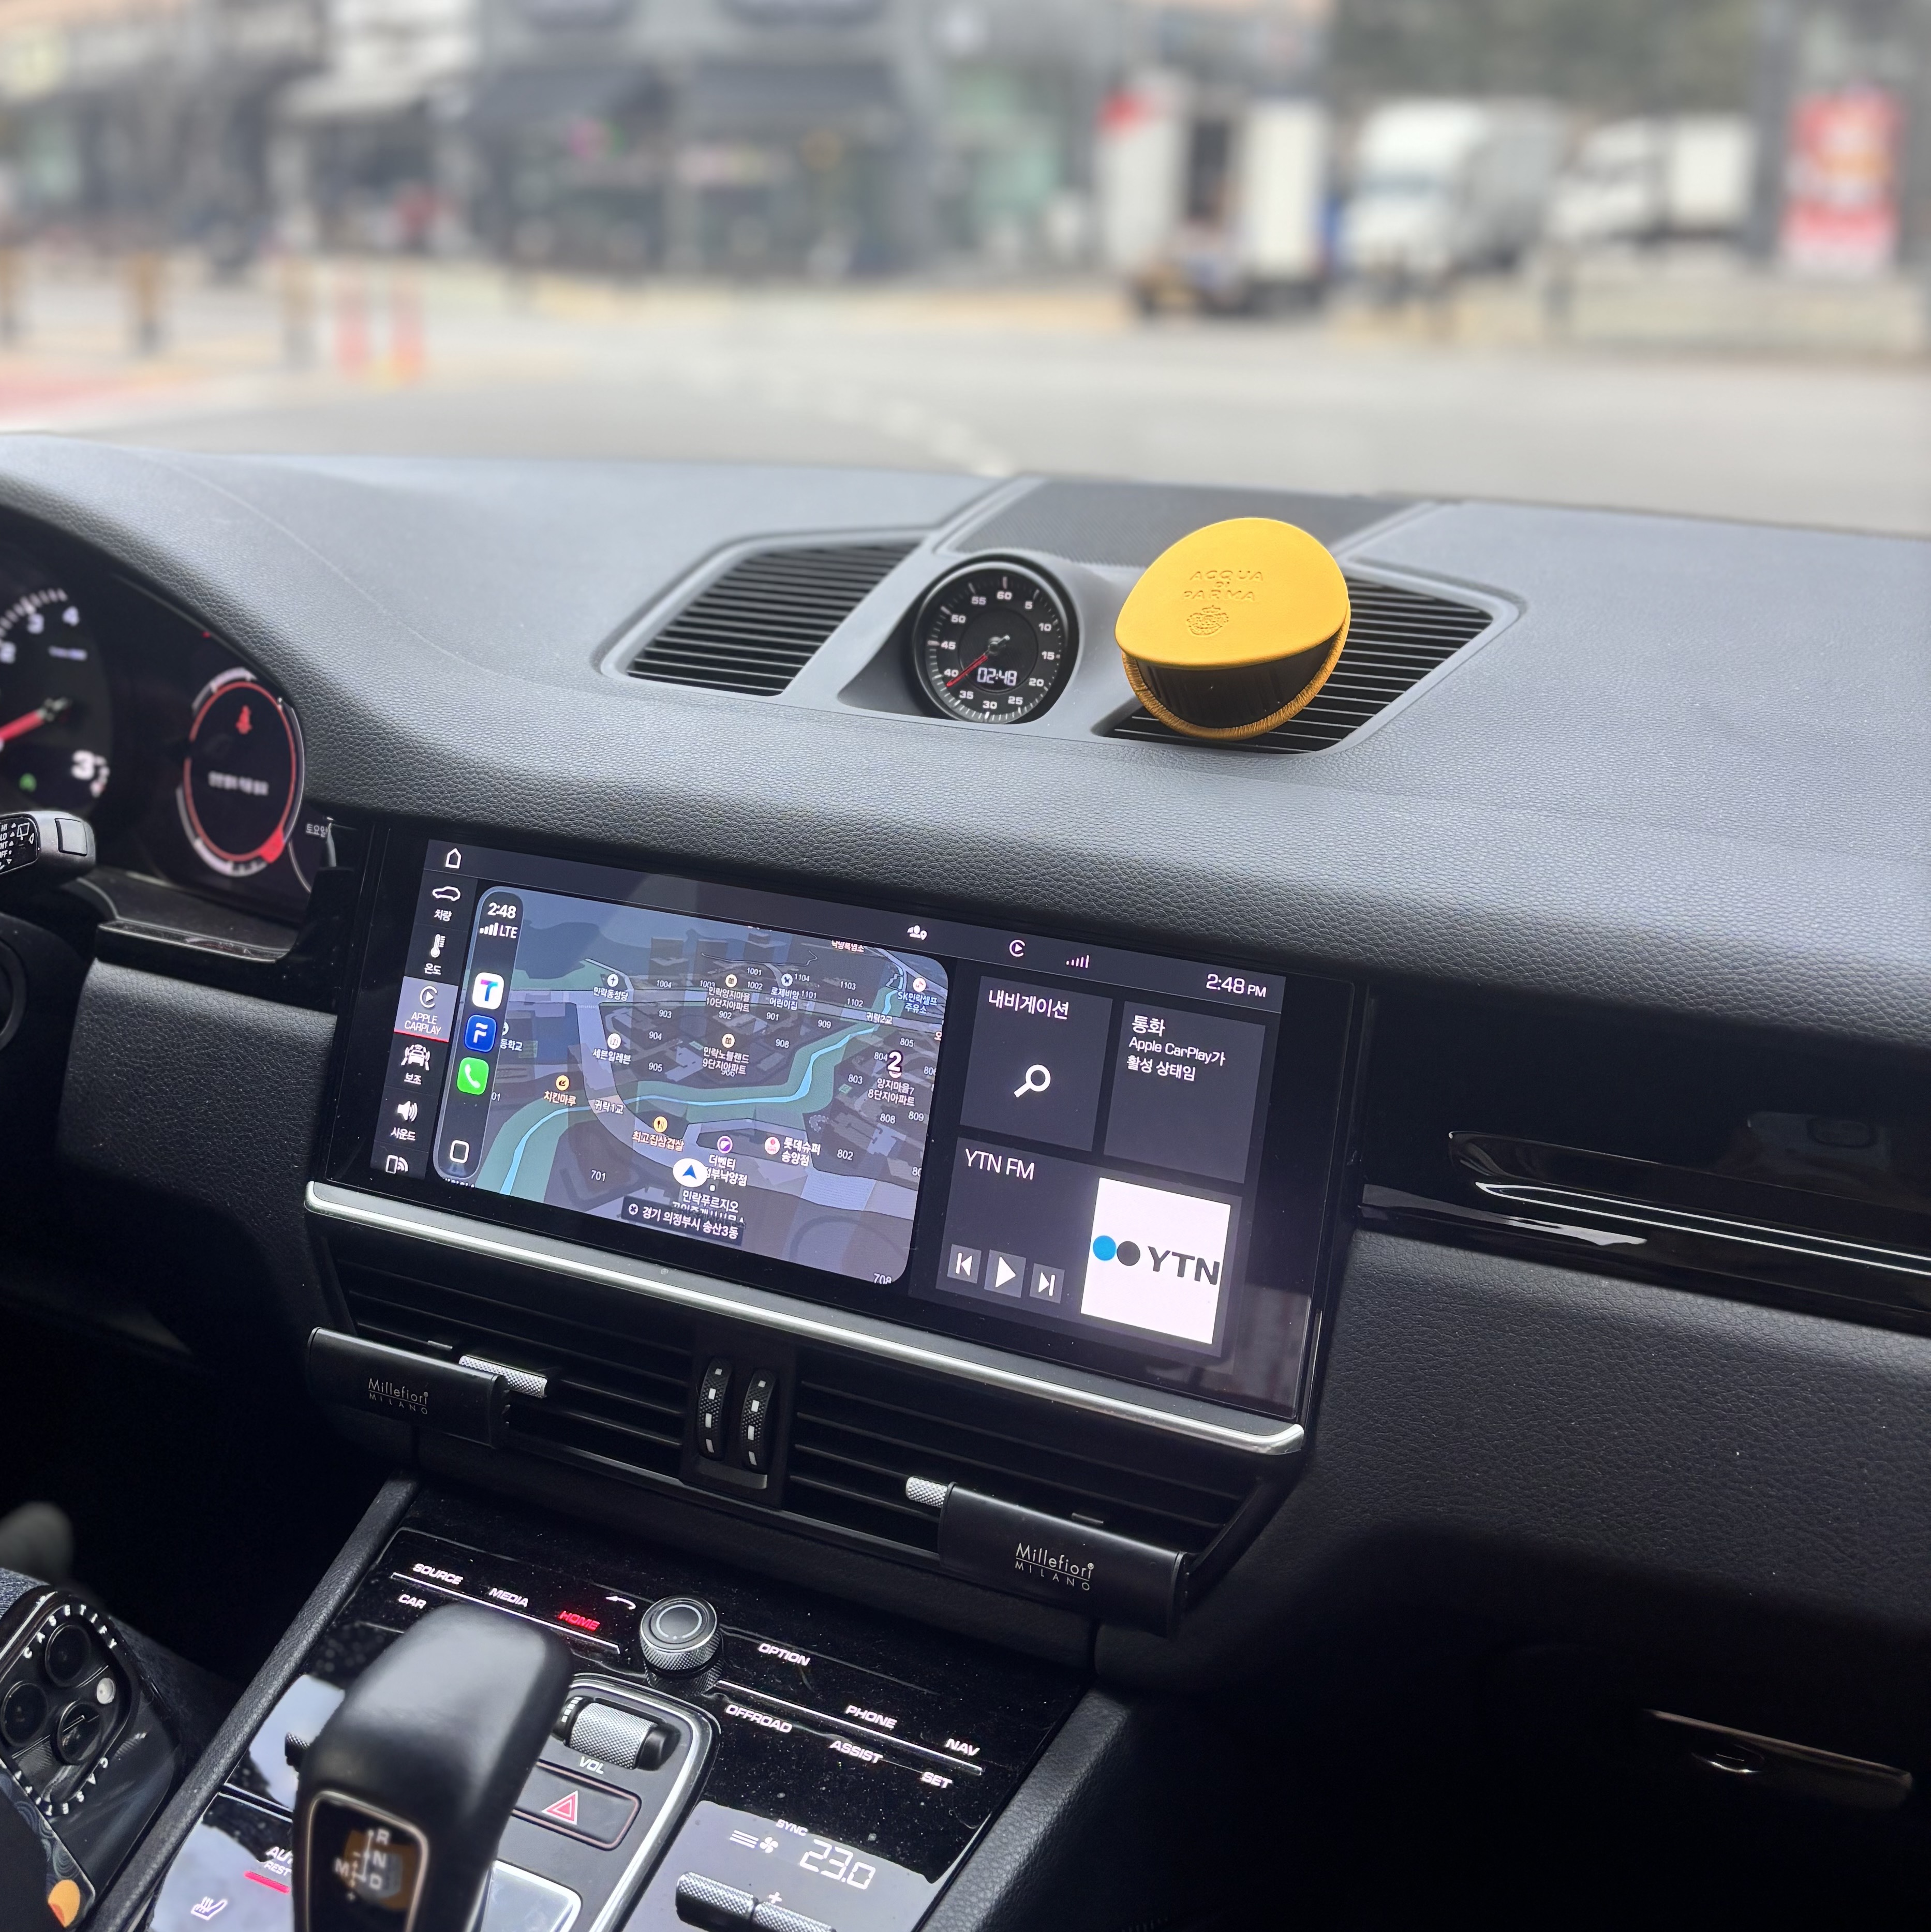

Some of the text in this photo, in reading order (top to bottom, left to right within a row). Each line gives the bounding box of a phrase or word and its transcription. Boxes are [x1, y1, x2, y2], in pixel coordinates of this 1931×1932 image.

[971, 597, 986, 605] 55
[997, 591, 1012, 600] 60
[1024, 601, 1033, 610] 5
[951, 615, 966, 623] 50
[1038, 622, 1052, 632] 10
[941, 641, 956, 650] 45
[1042, 651, 1054, 660] 15
[944, 668, 959, 677] 40
[977, 667, 1018, 686] 02:48
[1029, 678, 1044, 687] 20
[959, 690, 974, 700] 35
[1008, 695, 1023, 705] 25
[983, 700, 998, 709] 30
[434, 909, 452, 922] 차량
[487, 902, 516, 919] 2:48
[499, 925, 518, 939] LTE
[424, 963, 441, 975] 온도
[747, 968, 762, 976] 1001
[657, 979, 672, 988] 1004
[795, 973, 810, 982] 1104
[747, 981, 763, 990] 1002
[840, 981, 856, 990] 1103
[1206, 973, 1267, 998] 2:48 PM
[593, 987, 629, 1001] 민락동성당
[708, 986, 750, 1003] 민락양지마을
[801, 990, 817, 999] 1101
[706, 997, 750, 1013] 10단지아파트
[769, 998, 798, 1010] 어린이집
[847, 998, 864, 1007] 1102
[904, 1002, 927, 1014] 주유소
[988, 989, 1070, 1020] 내비게이션
[411, 1012, 438, 1025] APPLE
[659, 1009, 672, 1018] 903
[719, 1010, 732, 1020] 902
[766, 1012, 779, 1021] 901
[404, 1020, 442, 1035] CARPLAY
[818, 1019, 831, 1029] 909
[1132, 1015, 1166, 1037] 통화
[649, 1031, 662, 1041] 904
[900, 1038, 914, 1048] 805
[776, 1039, 790, 1049] 908
[1128, 1036, 1226, 1066] Apple CarPlay가
[592, 1048, 632, 1065] 세븐일레븐
[874, 1051, 888, 1061] 804
[887, 1051, 902, 1072] 2
[648, 1062, 663, 1073] 905
[702, 1058, 747, 1075] 9단지아파트
[1126, 1054, 1196, 1081] 활성 상태임
[404, 1073, 422, 1085] 보조
[848, 1074, 863, 1084] 803
[544, 1091, 576, 1106] 치킨마루
[868, 1089, 915, 1107] 8단지아파트
[880, 1113, 896, 1124] 808
[908, 1111, 925, 1122] 809
[391, 1127, 416, 1141] 사운드
[632, 1130, 685, 1152] 최고집삼겹살
[783, 1137, 821, 1156] 롯데슈퍼
[709, 1154, 736, 1170] 더벤티
[781, 1150, 810, 1167] 송양점
[837, 1149, 854, 1161] 802
[965, 1147, 1035, 1180] YTN FM
[591, 1169, 606, 1182] 701
[682, 1190, 739, 1213] 민락푸르지오
[642, 1206, 661, 1222] 경기
[663, 1211, 701, 1231] 의정부시
[703, 1221, 739, 1240] 송산3동
[1147, 1245, 1221, 1285] YTN
[368, 1377, 428, 1405] Millefiori
[369, 1392, 428, 1415] MILANO
[1015, 1542, 1094, 1579] Millefiori
[412, 1563, 464, 1585] SOURCE
[1015, 1561, 1090, 1591] MILANO
[398, 1593, 427, 1610] CAR
[488, 1587, 529, 1608] MEDIA
[558, 1610, 600, 1631] HOME
[757, 1642, 811, 1666] OPTION
[725, 1703, 793, 1733] OFFROAD
[844, 1704, 898, 1729] PHONE
[829, 1740, 884, 1764] ASSIST
[946, 1738, 981, 1757] NAV
[580, 1756, 604, 1775] VOL
[921, 1771, 953, 1789] SET
[776, 1818, 808, 1837] SYNC
[263, 1860, 292, 1876] REST
[799, 1838, 876, 1890] 23.0
